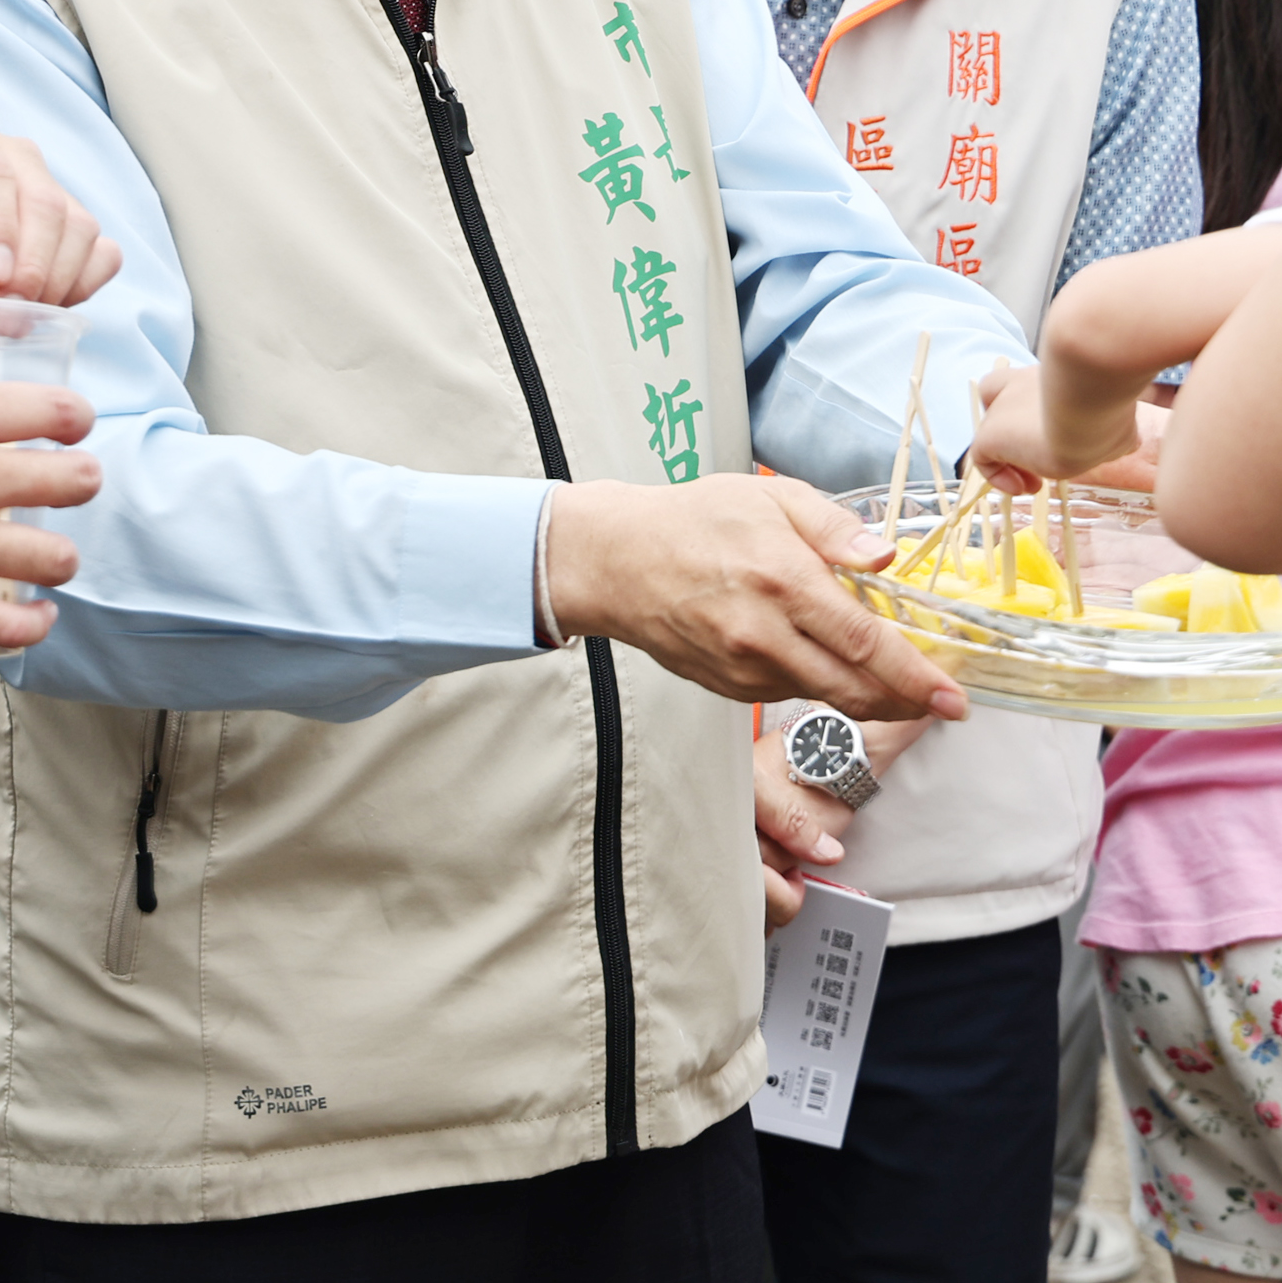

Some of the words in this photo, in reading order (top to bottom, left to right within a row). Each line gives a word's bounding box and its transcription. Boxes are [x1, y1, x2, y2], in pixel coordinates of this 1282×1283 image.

[936, 29, 1002, 285] 關廟區
[577, 111, 705, 484] 黃偉哲
[265, 1084, 314, 1099] PADER
[266, 1097, 328, 1114] PHALIPE
